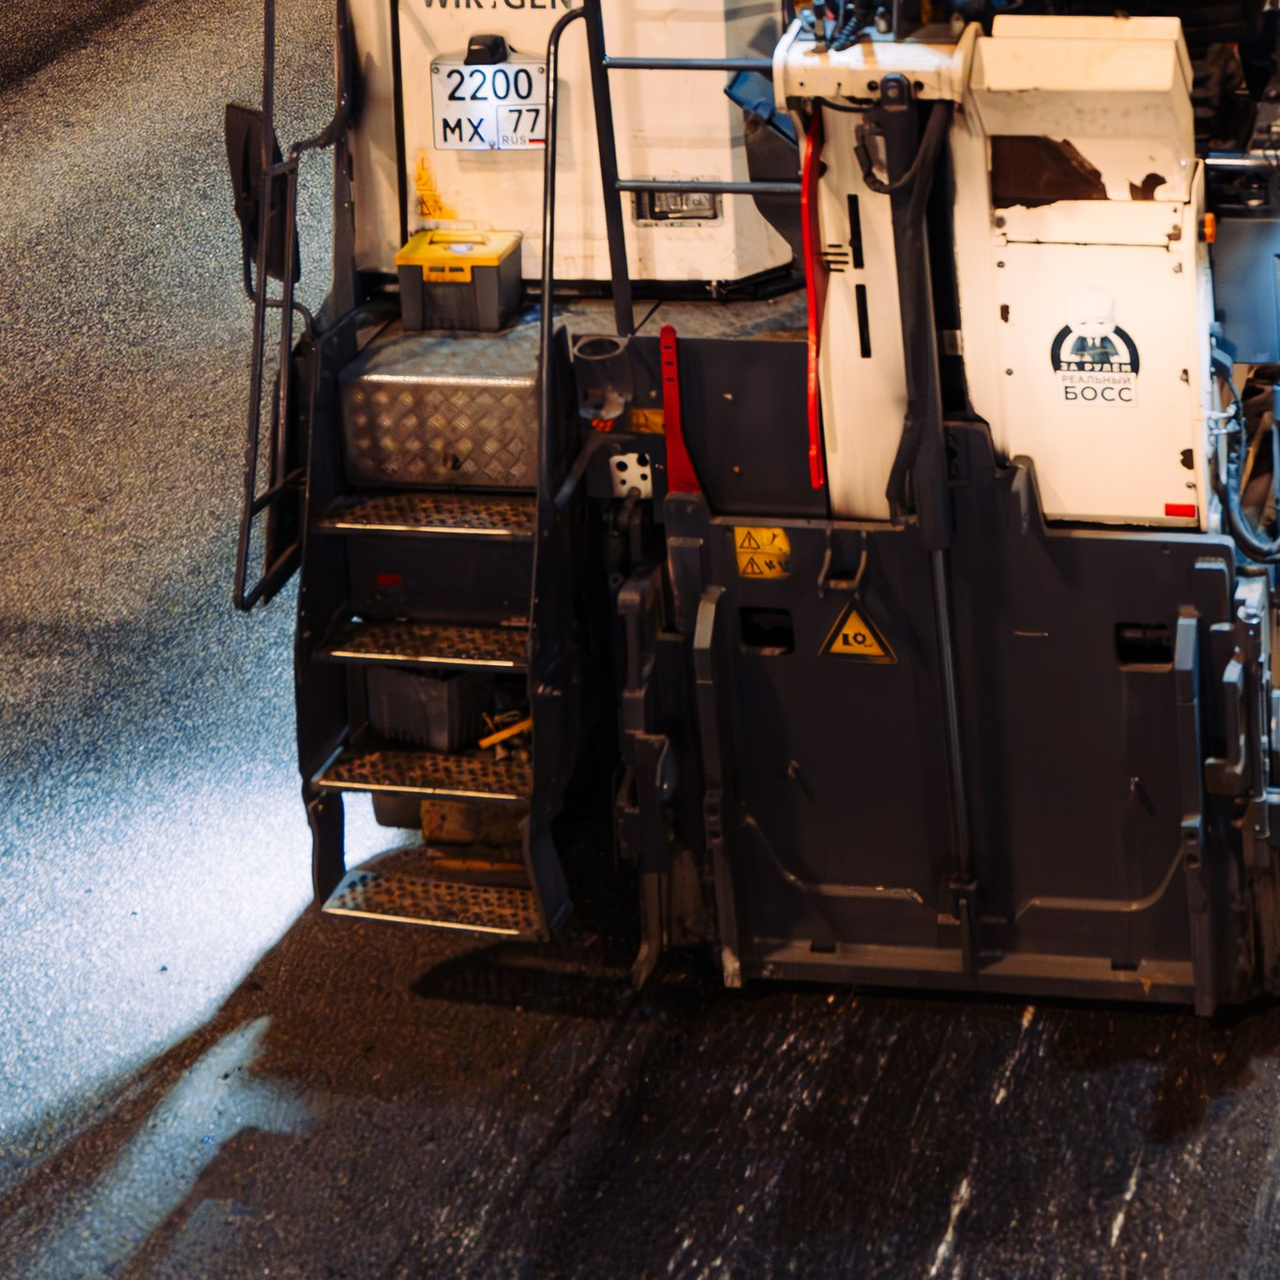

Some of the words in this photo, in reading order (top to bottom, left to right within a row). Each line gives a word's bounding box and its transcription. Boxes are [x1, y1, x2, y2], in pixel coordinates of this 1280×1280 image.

[447, 69, 533, 101] 2200
[508, 109, 540, 133] 77
[502, 135, 527, 144] RUS
[1061, 375, 1131, 385] РЕАЛЬНЫЙ
[1064, 386, 1132, 402] БОСС
